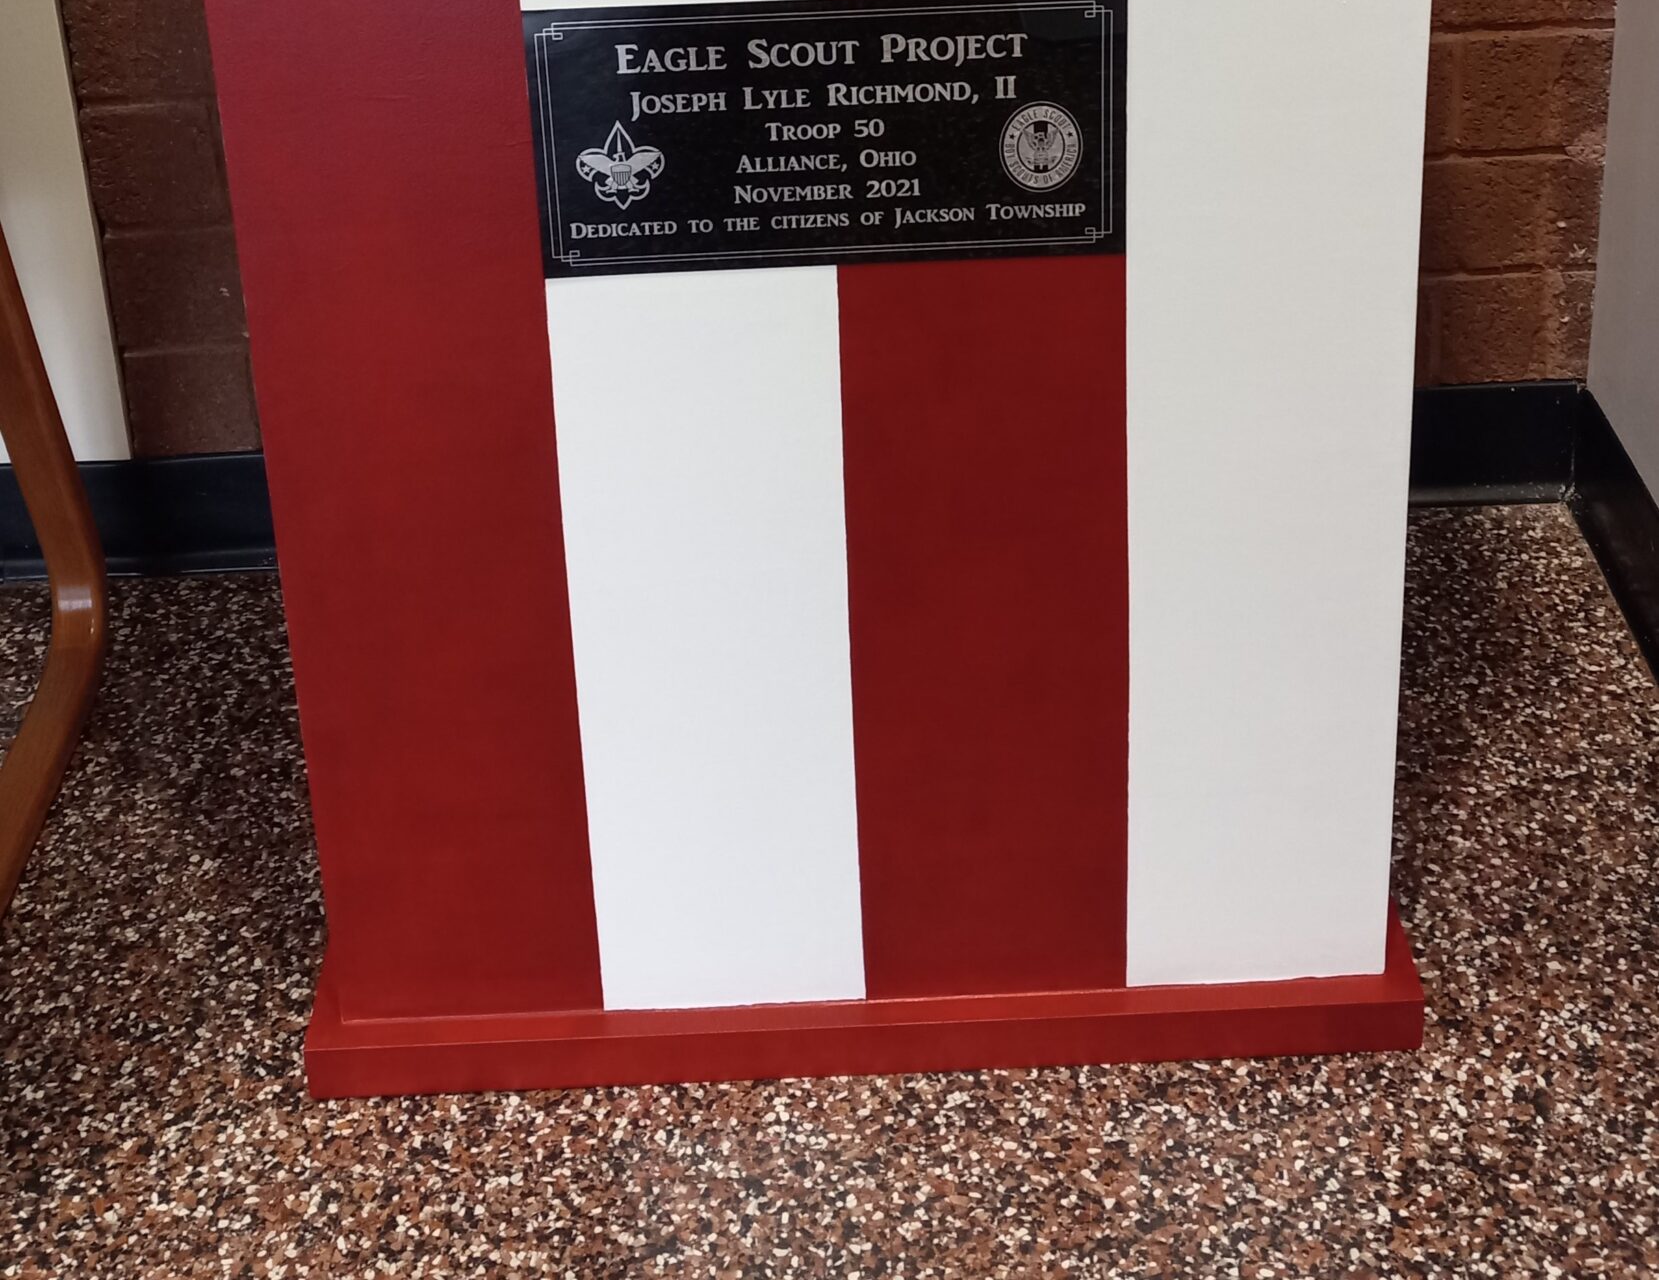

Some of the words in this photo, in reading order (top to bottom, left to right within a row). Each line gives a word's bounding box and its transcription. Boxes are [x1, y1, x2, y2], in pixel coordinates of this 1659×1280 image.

[614, 43, 728, 75] EAGLE
[746, 38, 860, 69] SCOUT
[880, 33, 1028, 67] PROJECT
[629, 91, 728, 121] JOSEPH
[742, 86, 811, 110] LYLE
[827, 81, 980, 107] RICHMOND,
[994, 75, 1017, 99] II
[764, 122, 841, 142] TROOP
[853, 118, 885, 138] 50
[1011, 109, 1039, 132] EAGLE
[1042, 108, 1071, 130] SCOUT
[735, 154, 848, 174] ALLIANCE,
[859, 148, 917, 168] OHIO
[1008, 160, 1040, 185] SCOUTS
[1042, 173, 1054, 185] OF
[1054, 143, 1077, 178] AMERICA
[733, 183, 854, 204] NOVEMBER
[865, 178, 921, 198] 2021
[570, 220, 678, 239] DEDICATED
[688, 219, 714, 233] TO
[723, 217, 761, 232] THE
[770, 212, 850, 229] CITIZENS
[860, 211, 884, 226] OF
[894, 207, 975, 229] JACKSON
[985, 202, 1086, 220] TOWNSHIP
